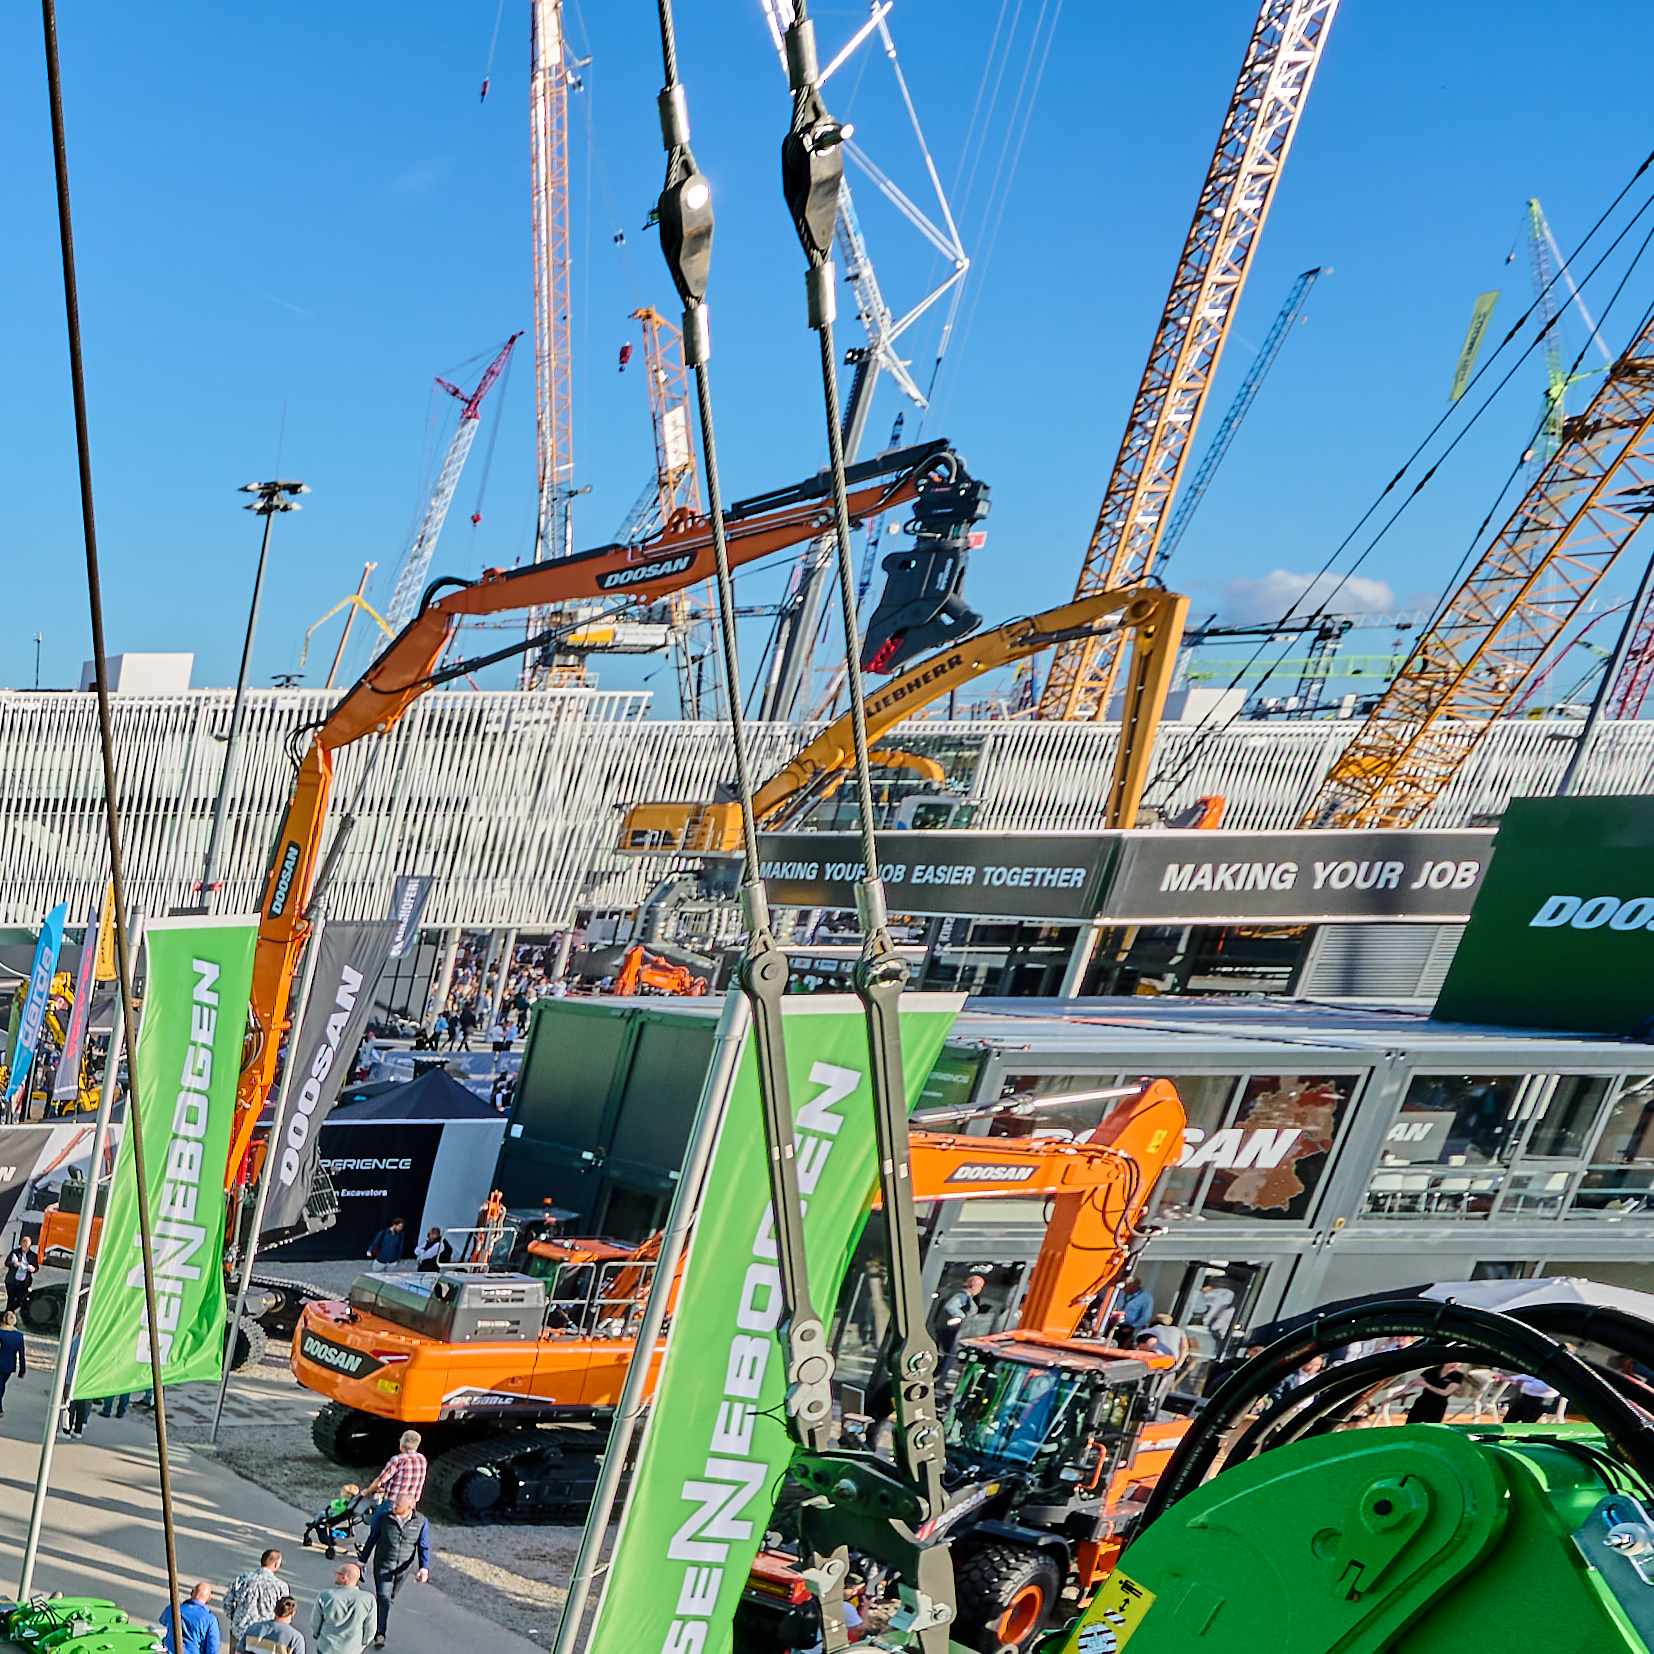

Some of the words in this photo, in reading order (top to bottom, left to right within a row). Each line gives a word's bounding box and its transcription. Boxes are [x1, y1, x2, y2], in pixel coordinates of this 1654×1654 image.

[604, 556, 691, 589] DOOSAN
[866, 654, 963, 719] LIEBHERR
[273, 842, 299, 914] DOOSAN
[759, 861, 820, 881] MAKING
[878, 864, 906, 883] OB
[910, 864, 975, 886] EASIER
[982, 867, 1087, 889] TOGETHER
[1159, 862, 1300, 893] MAKING
[1311, 860, 1407, 891] YOUR
[1410, 860, 1482, 891] JOB
[1528, 895, 1654, 932] DOO
[280, 965, 366, 1187] DOOSAN
[127, 959, 222, 1367] SENNEBOGEN
[953, 1166, 1034, 1181] DOOSAN
[304, 1336, 363, 1373] DOOSAN
